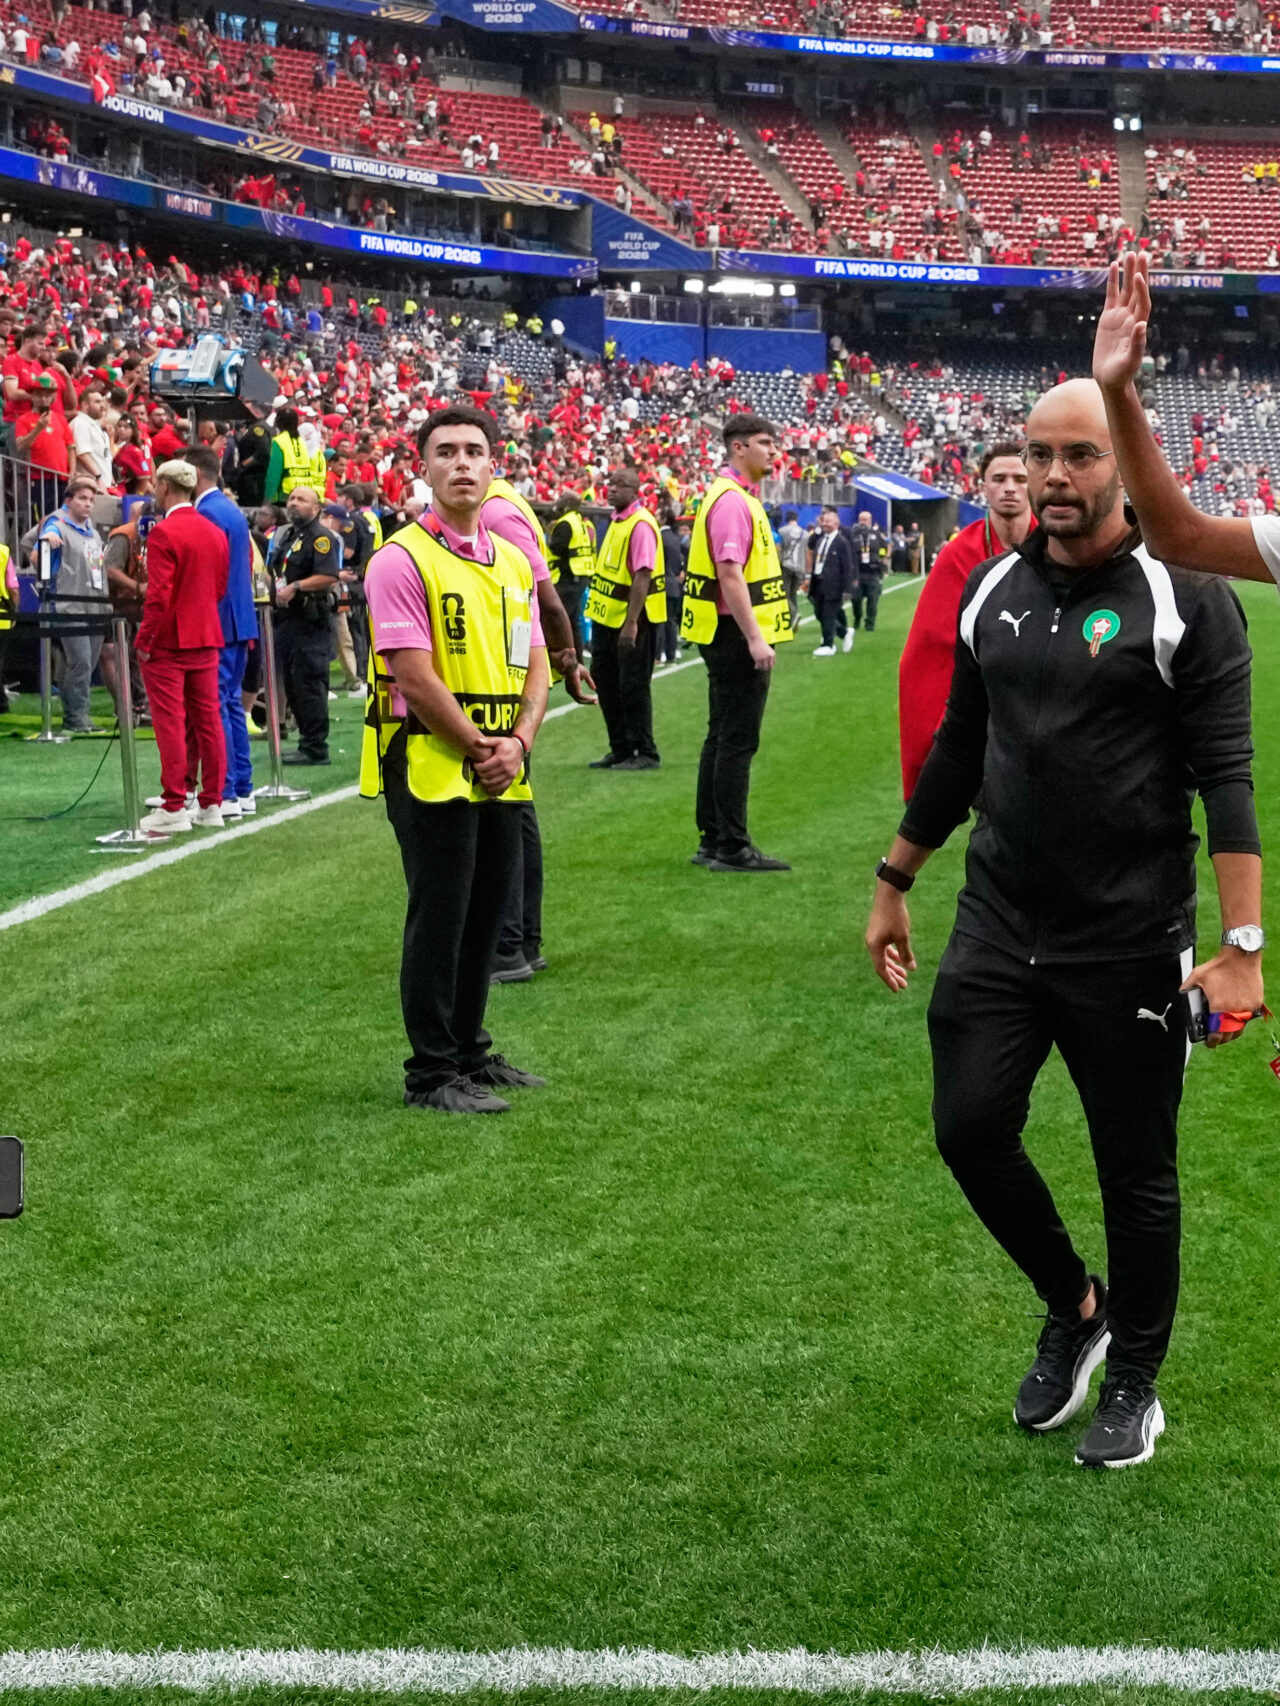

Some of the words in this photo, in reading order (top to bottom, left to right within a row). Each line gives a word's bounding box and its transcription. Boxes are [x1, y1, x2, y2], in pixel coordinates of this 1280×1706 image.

[473, 3, 512, 13] WORLD
[514, 3, 536, 13] CUP
[485, 14, 524, 23] 2026
[631, 22, 689, 39] HOUSTON
[798, 38, 823, 51] FIFA
[824, 40, 866, 54] WORLD
[867, 43, 891, 56] CUP
[892, 45, 935, 58] 2026
[1045, 54, 1106, 65] HOUSTON
[102, 96, 164, 123] HOUSTON
[330, 156, 353, 170] FIFA
[353, 160, 386, 176] WORLD
[388, 166, 406, 181] CUP
[406, 170, 438, 185] 2026
[624, 232, 644, 240] FIFA
[360, 235, 383, 251] FIFA
[385, 238, 422, 256] WORLD
[423, 243, 443, 259] CUP
[444, 248, 481, 264] 2026
[608, 241, 641, 250] WORLD
[642, 241, 660, 251] CUP
[814, 260, 846, 275] FIFA
[846, 262, 898, 277] WORLD
[899, 265, 927, 279] CUP
[927, 267, 980, 282] 2026
[1149, 274, 1224, 288] HOUSTON
[380, 621, 415, 629] SECURITY
